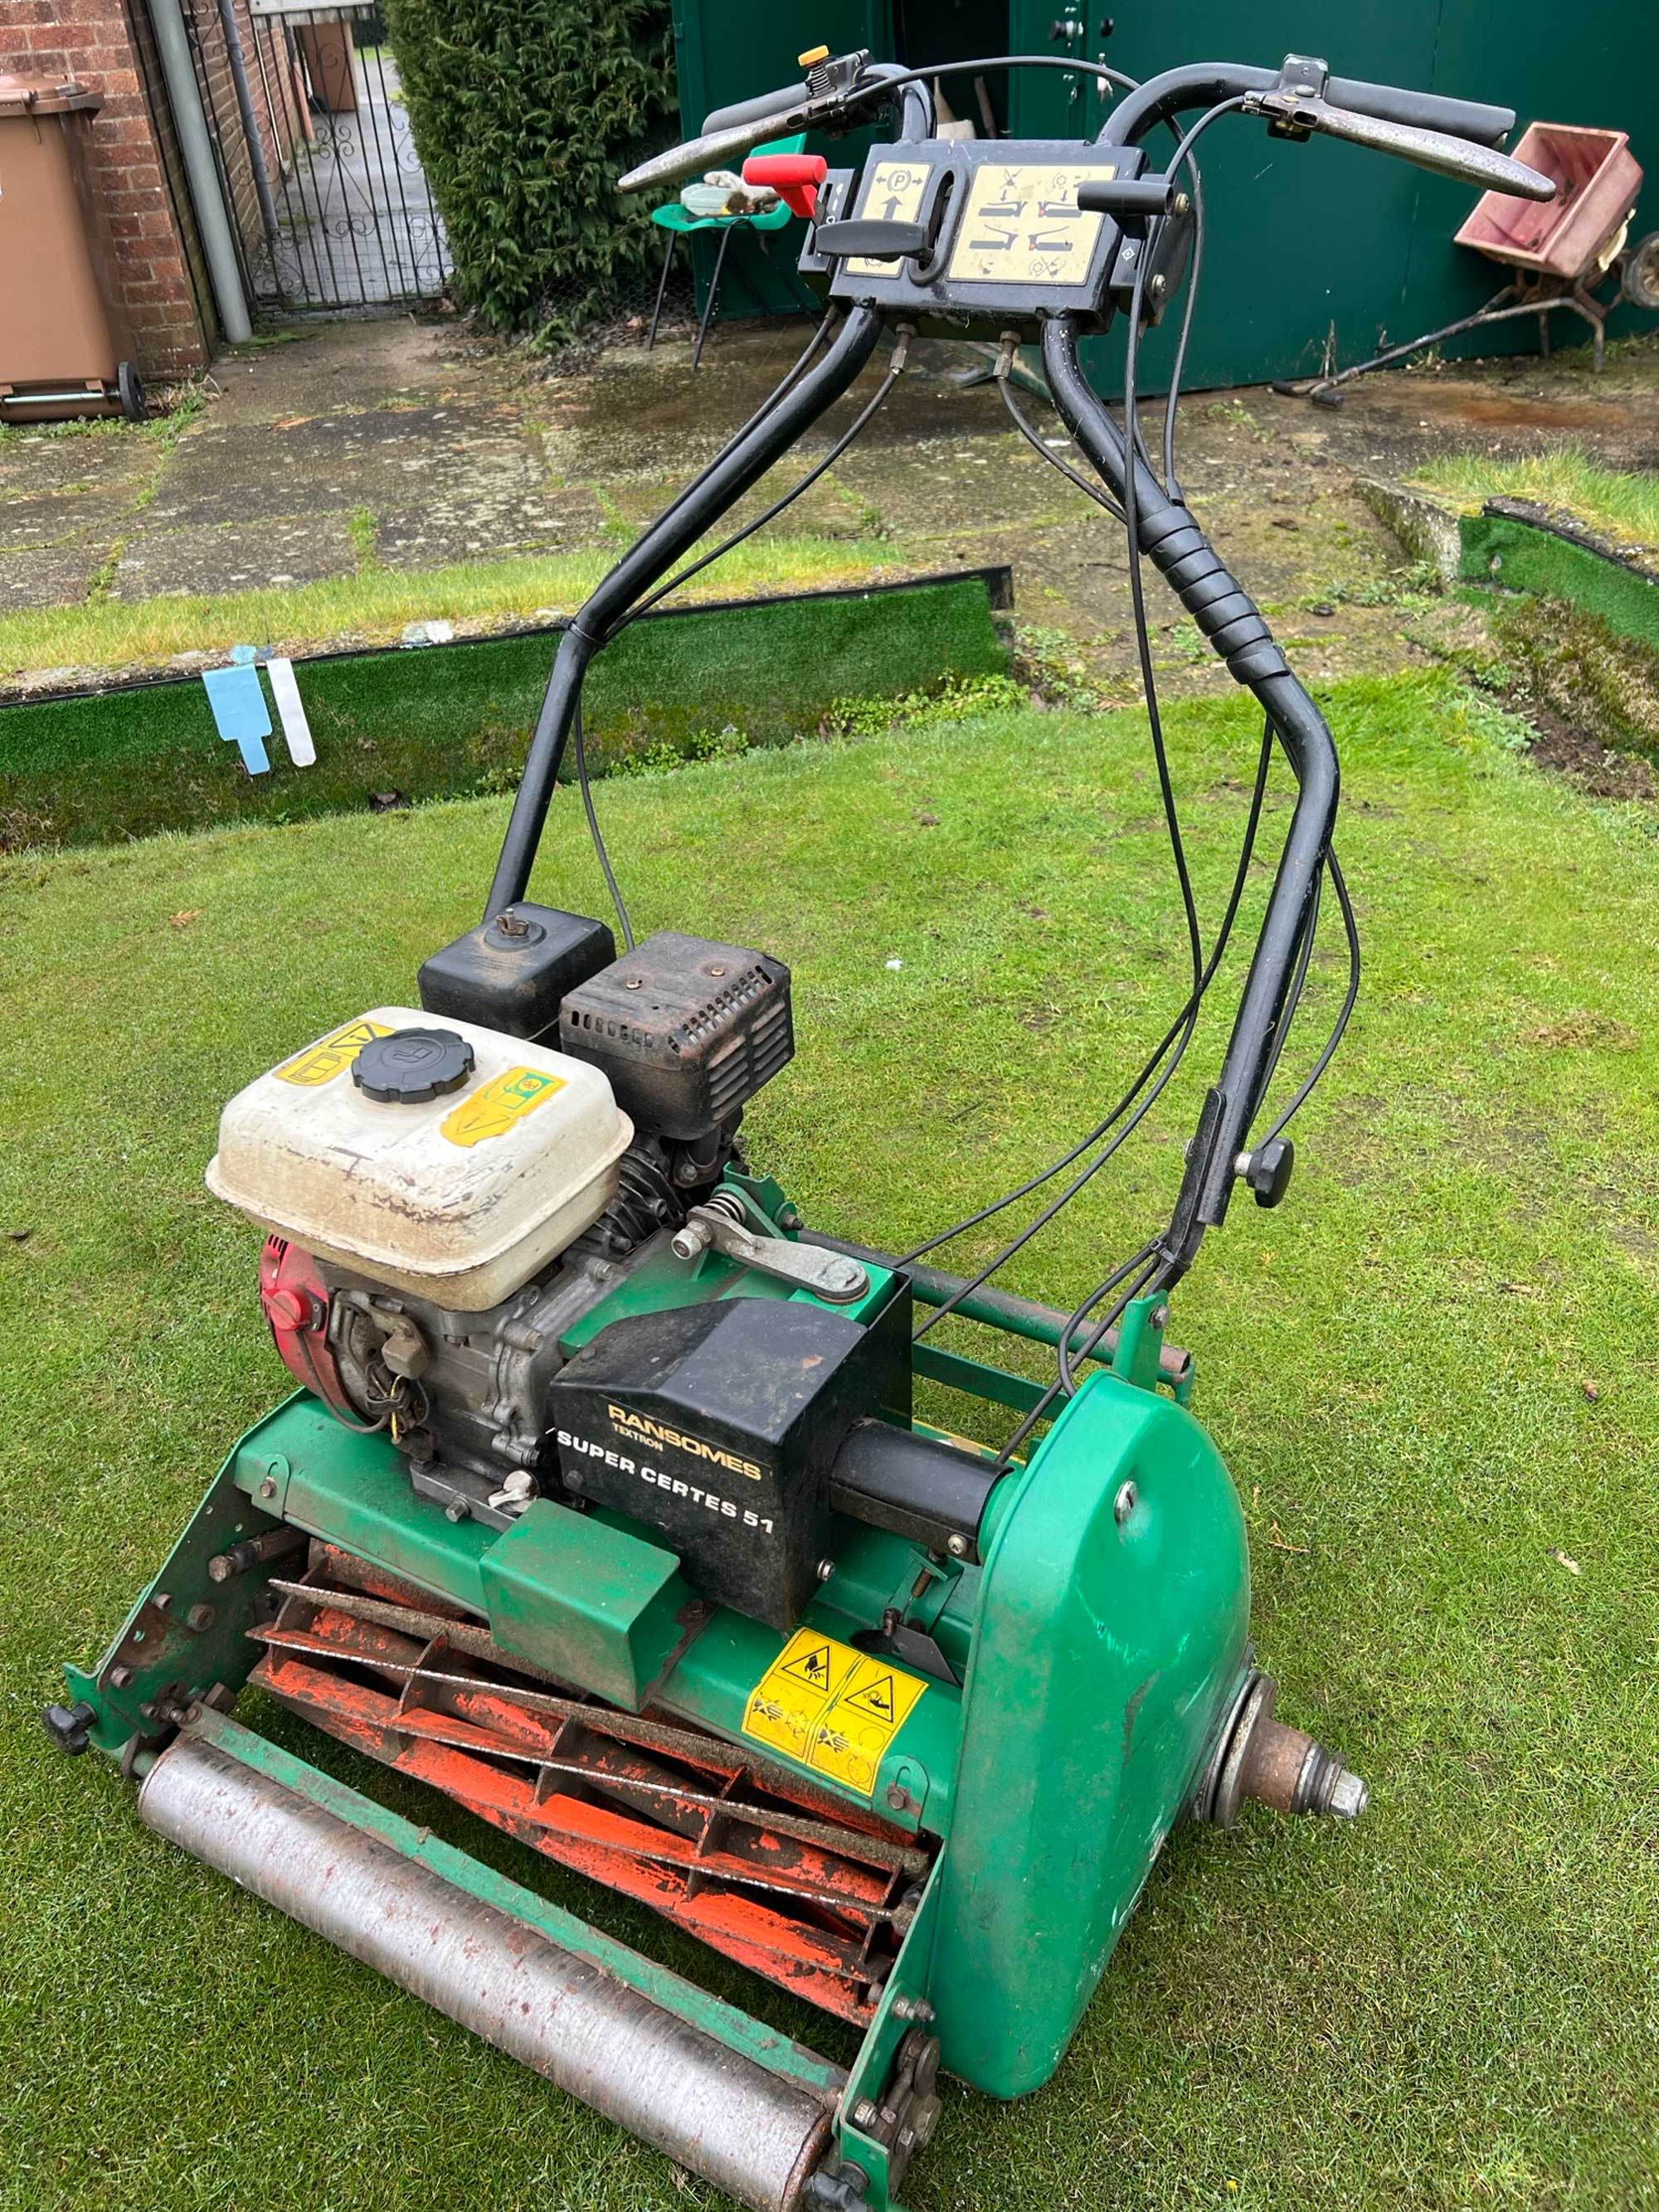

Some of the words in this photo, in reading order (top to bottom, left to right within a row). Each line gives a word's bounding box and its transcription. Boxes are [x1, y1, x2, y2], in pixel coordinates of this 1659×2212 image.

[894, 175, 905, 187] P
[608, 1404, 761, 1481] RANSOMES
[611, 1422, 664, 1451] TEXTRON
[557, 1430, 635, 1475] SUPER
[640, 1466, 737, 1518] CERTES
[742, 1510, 774, 1534] 51
